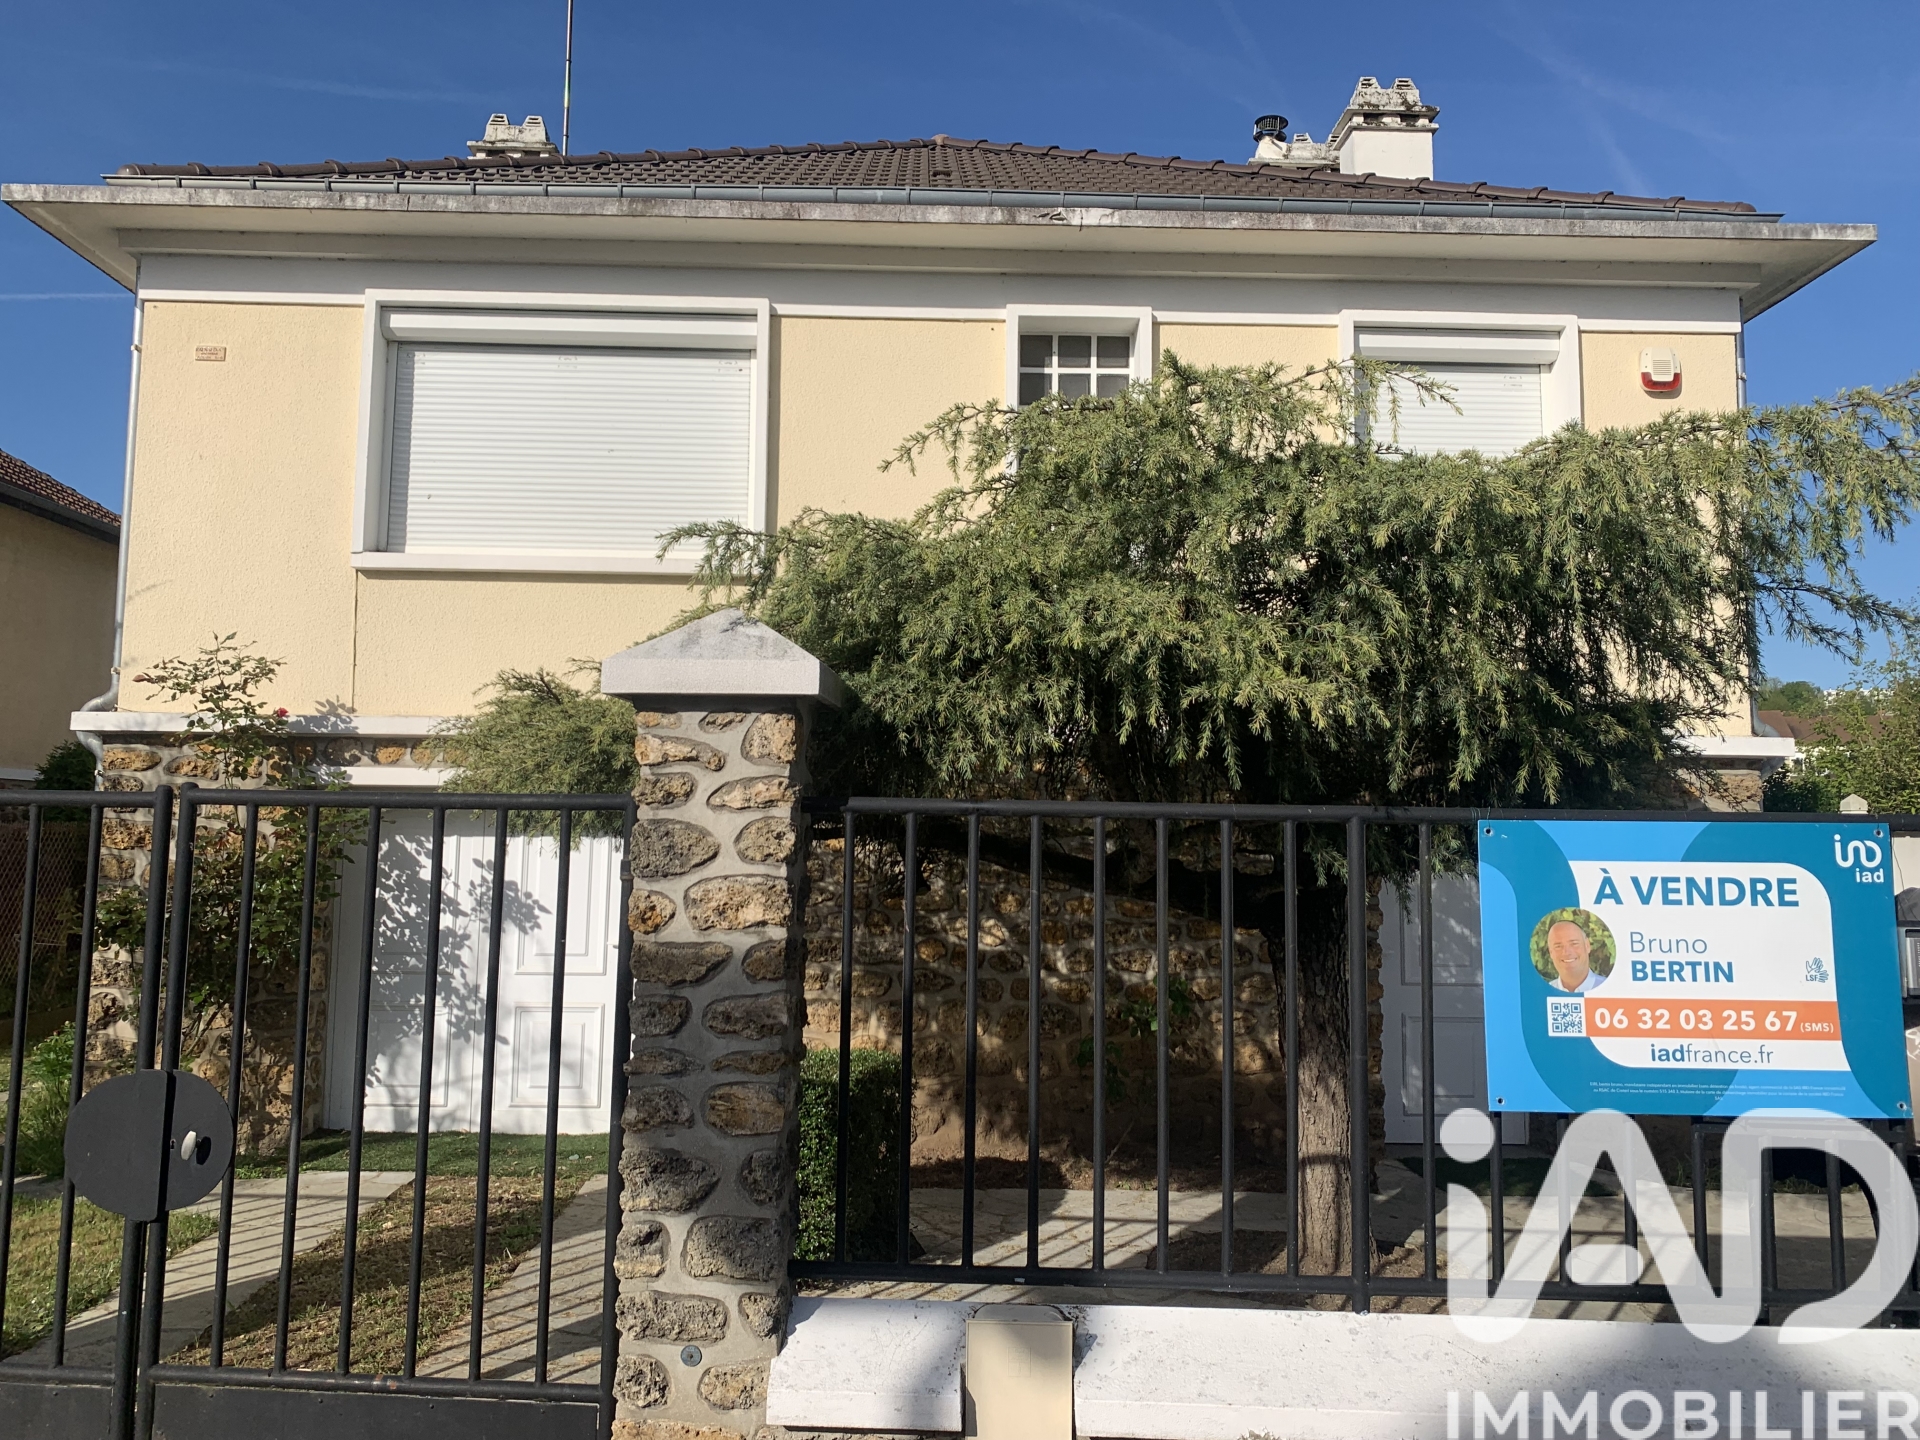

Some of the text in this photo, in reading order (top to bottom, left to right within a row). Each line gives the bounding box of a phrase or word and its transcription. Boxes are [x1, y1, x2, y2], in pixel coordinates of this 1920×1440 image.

[1855, 867, 1885, 883] iad
[1593, 867, 1800, 907] À VENDRE
[1629, 931, 1708, 954] Bruno
[1631, 960, 1734, 983] BERTIN
[1805, 974, 1819, 982] LSF
[1594, 1007, 1834, 1034] 06 32 03 25 67 (SMS)
[1650, 1043, 1774, 1064] iadfrance.fr
